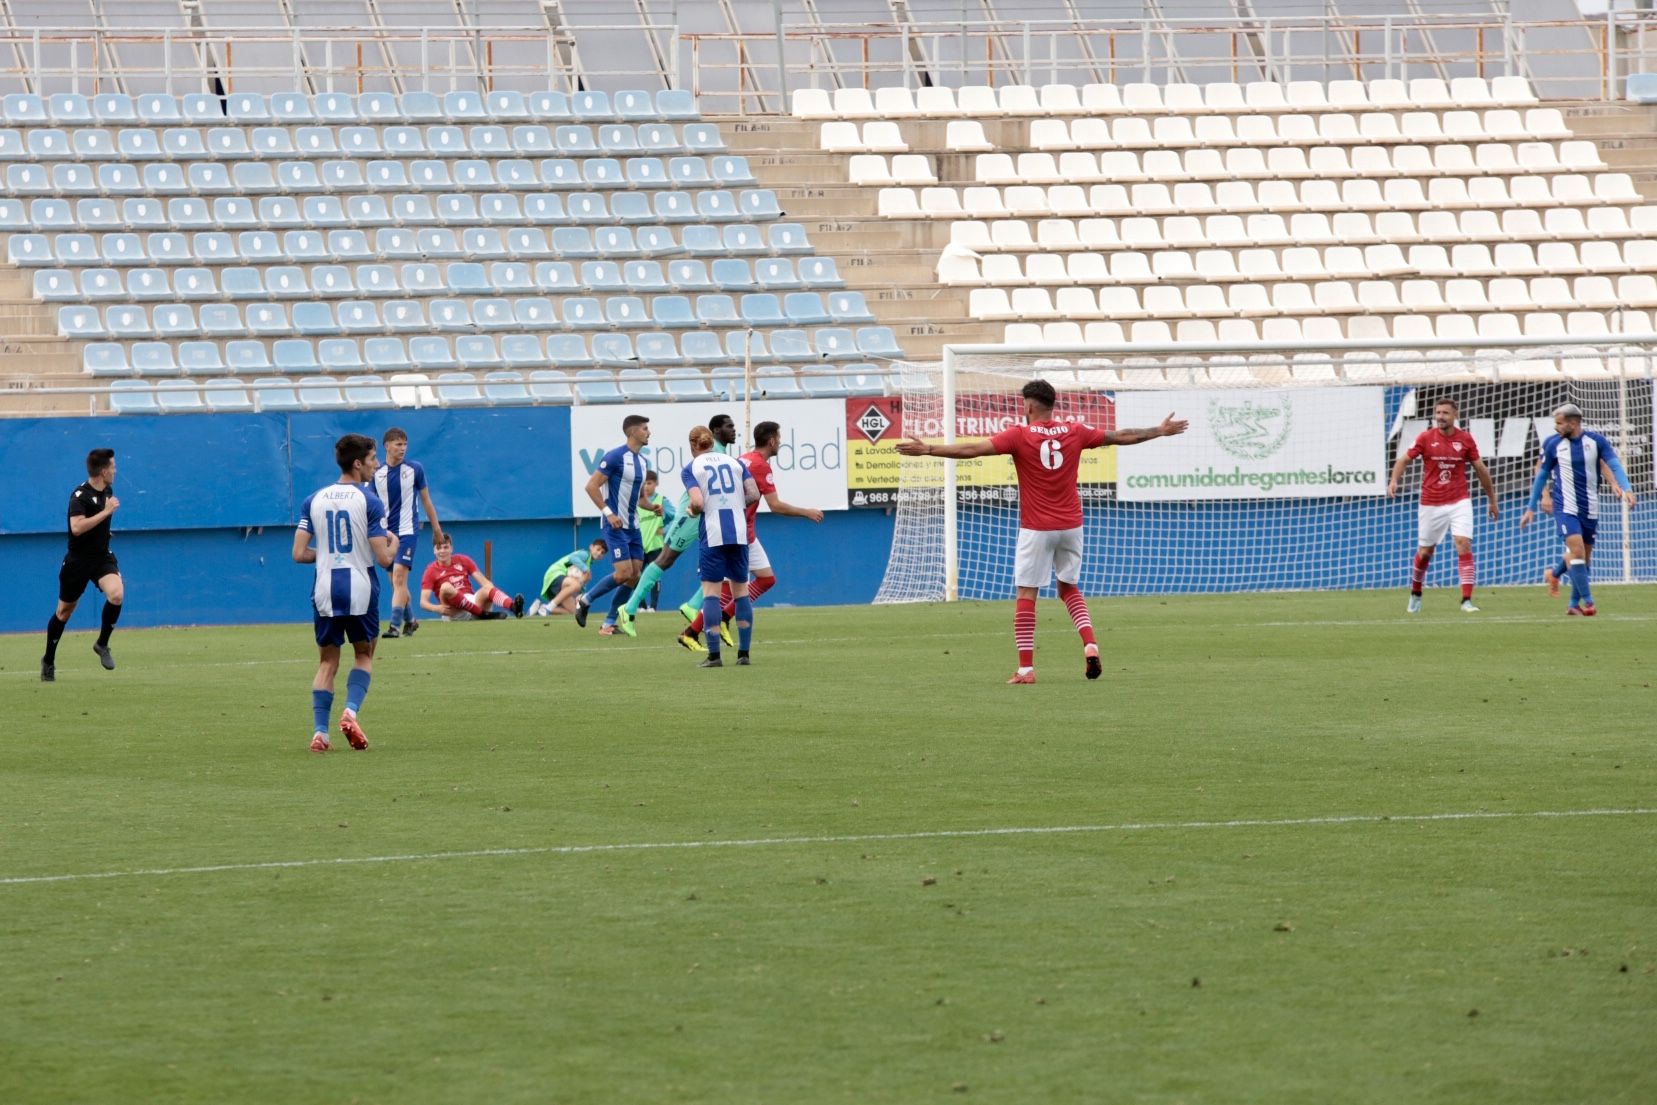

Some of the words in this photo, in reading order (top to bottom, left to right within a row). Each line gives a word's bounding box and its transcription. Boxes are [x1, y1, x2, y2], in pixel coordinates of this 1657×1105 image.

[861, 418, 885, 428] HGL
[1030, 424, 1069, 436] SERGIO
[1040, 439, 1064, 470] 6
[703, 463, 735, 496] 20
[322, 491, 357, 500] ALBERT
[325, 510, 353, 554] 10
